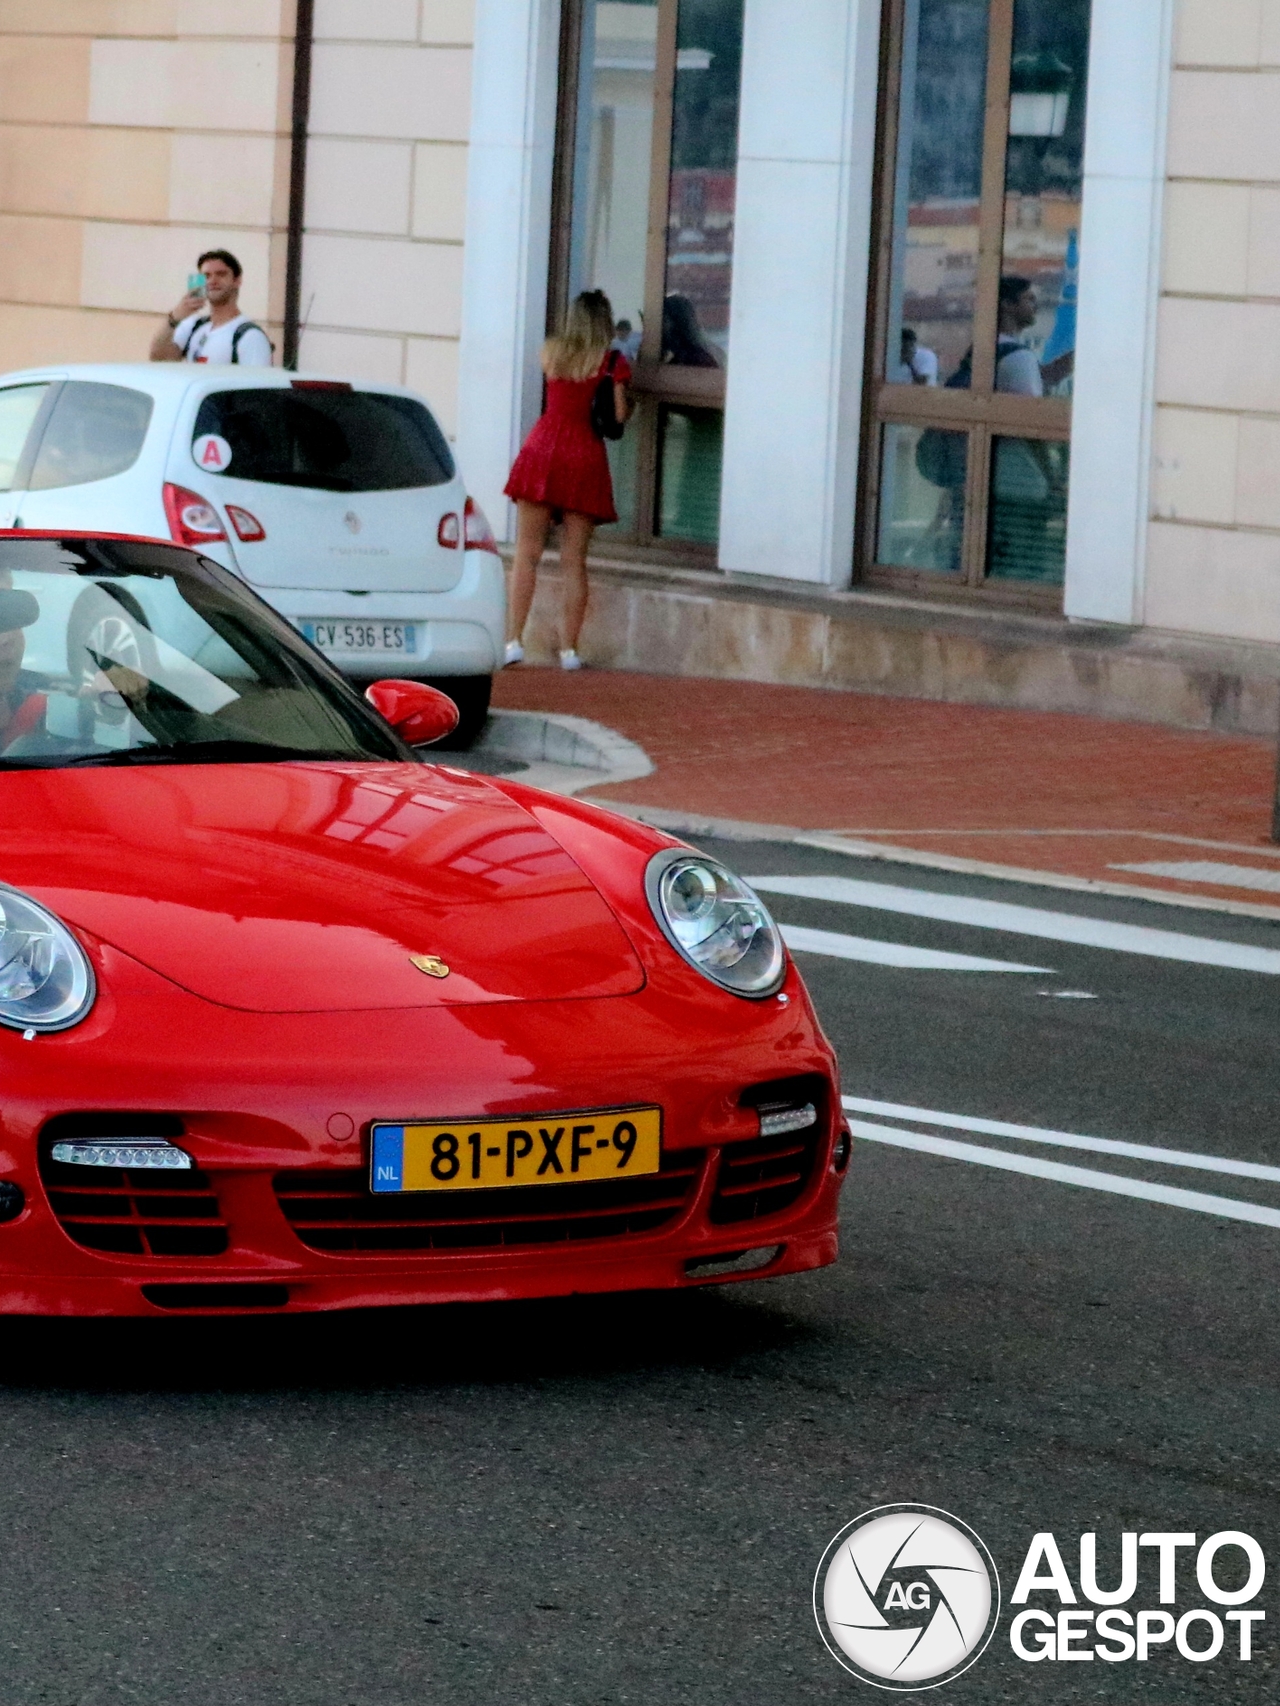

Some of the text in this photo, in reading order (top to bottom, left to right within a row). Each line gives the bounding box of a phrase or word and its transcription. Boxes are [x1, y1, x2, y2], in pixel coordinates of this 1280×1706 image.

[202, 440, 223, 466] A
[430, 1120, 638, 1181] 81-PXF-9
[377, 1166, 399, 1181] NL
